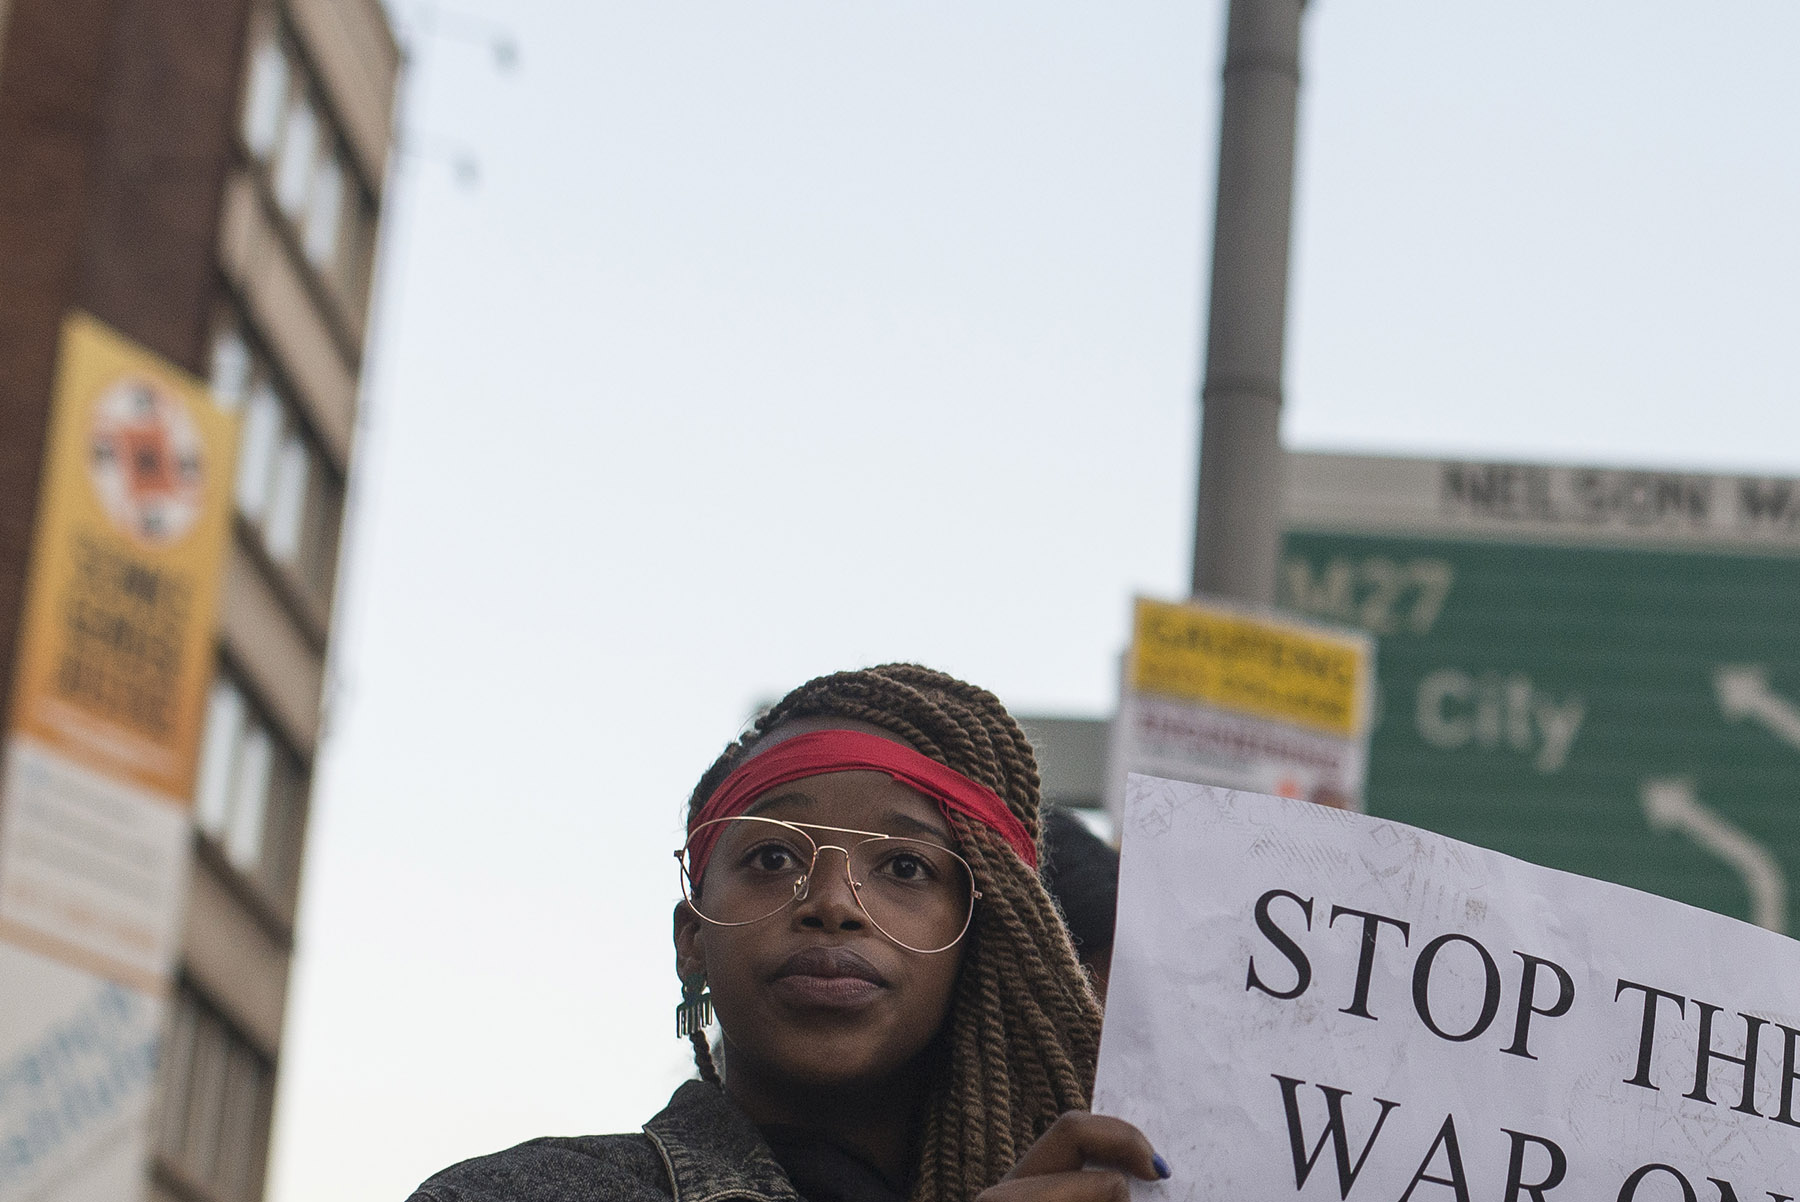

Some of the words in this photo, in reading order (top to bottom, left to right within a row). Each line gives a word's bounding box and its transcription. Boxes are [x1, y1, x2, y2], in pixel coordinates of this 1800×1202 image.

[1440, 464, 1706, 518] NELSON
[1282, 555, 1455, 635] M27
[1414, 669, 1585, 774] City
[1245, 888, 1575, 1061] STOP
